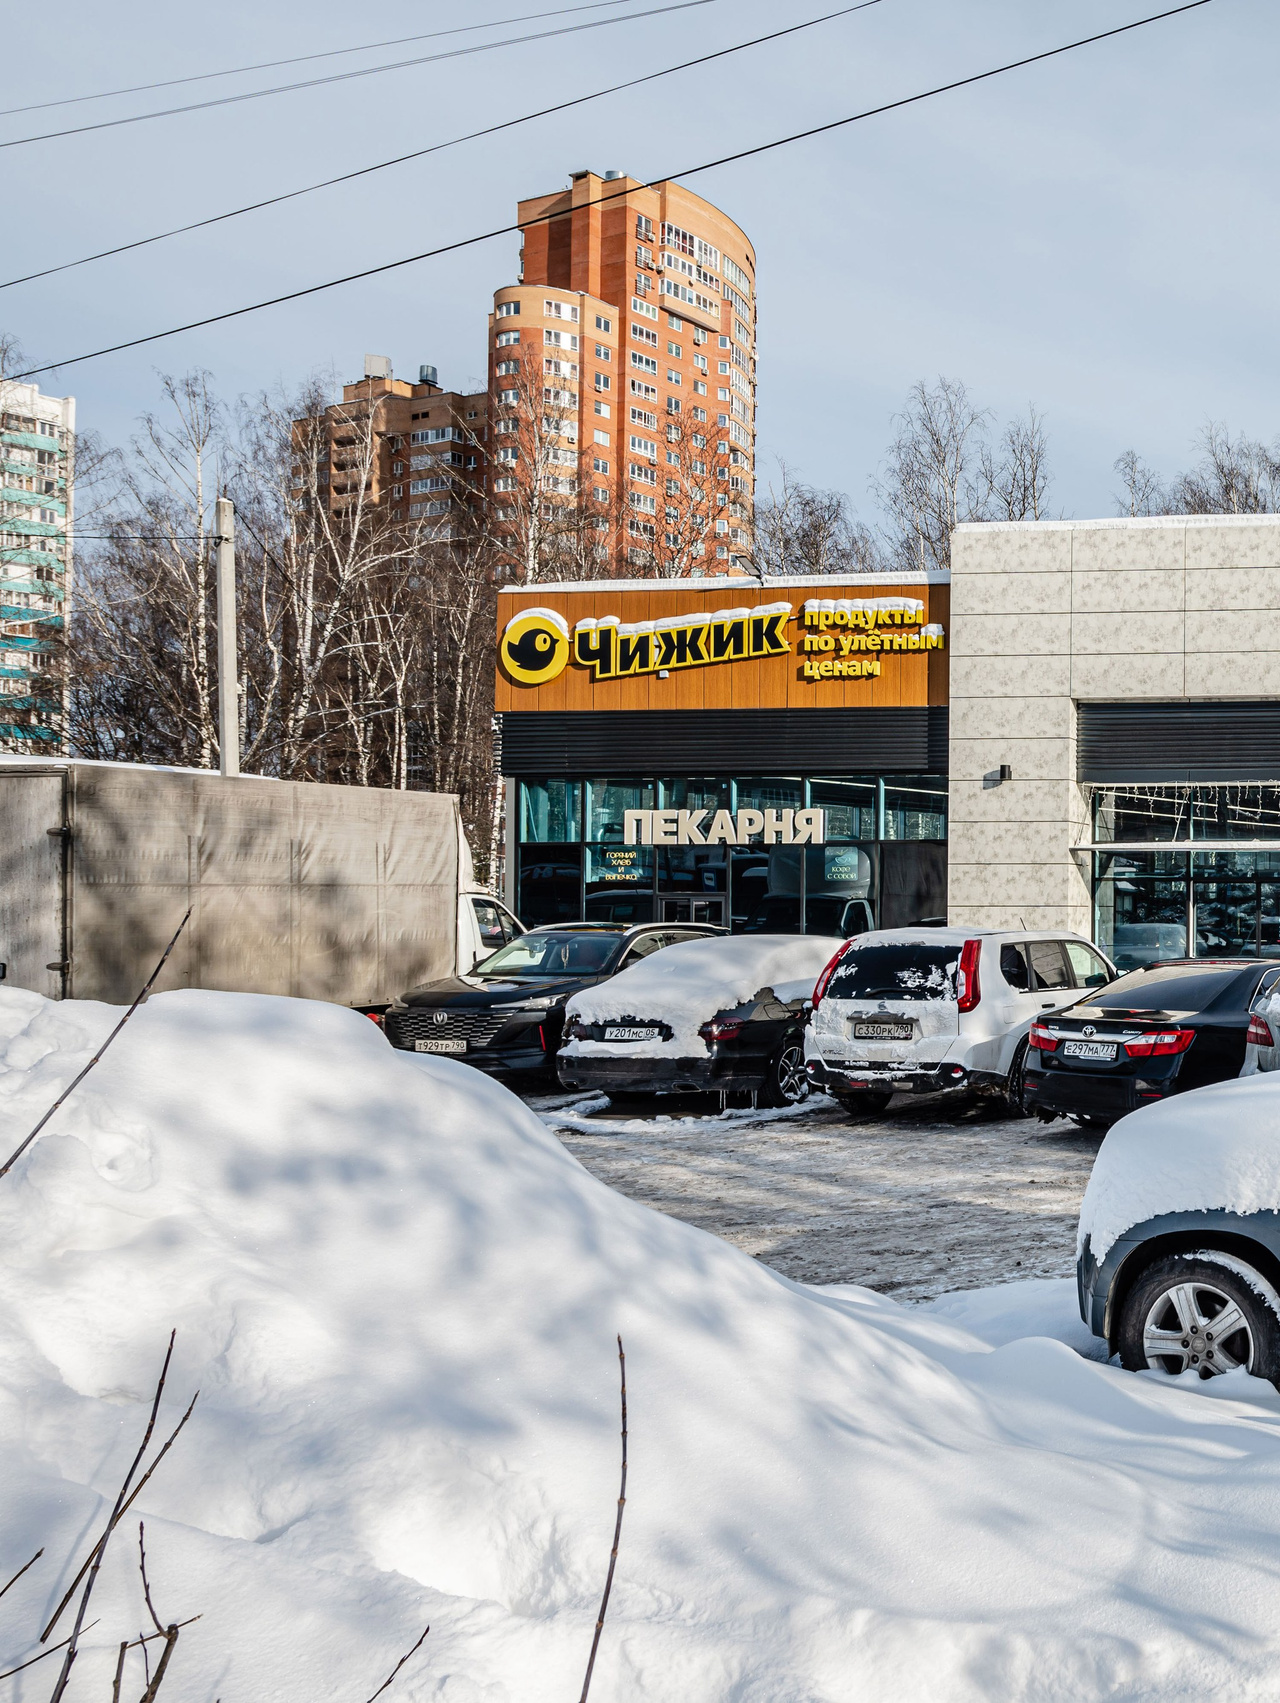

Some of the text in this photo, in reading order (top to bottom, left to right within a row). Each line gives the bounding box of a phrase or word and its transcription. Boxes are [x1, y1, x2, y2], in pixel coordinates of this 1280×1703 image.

[804, 608, 924, 630] продукты
[573, 611, 792, 680] Чижик
[804, 629, 945, 656] по улётным
[804, 660, 881, 680] ценам
[624, 809, 825, 845] ПЕКАРНЯ
